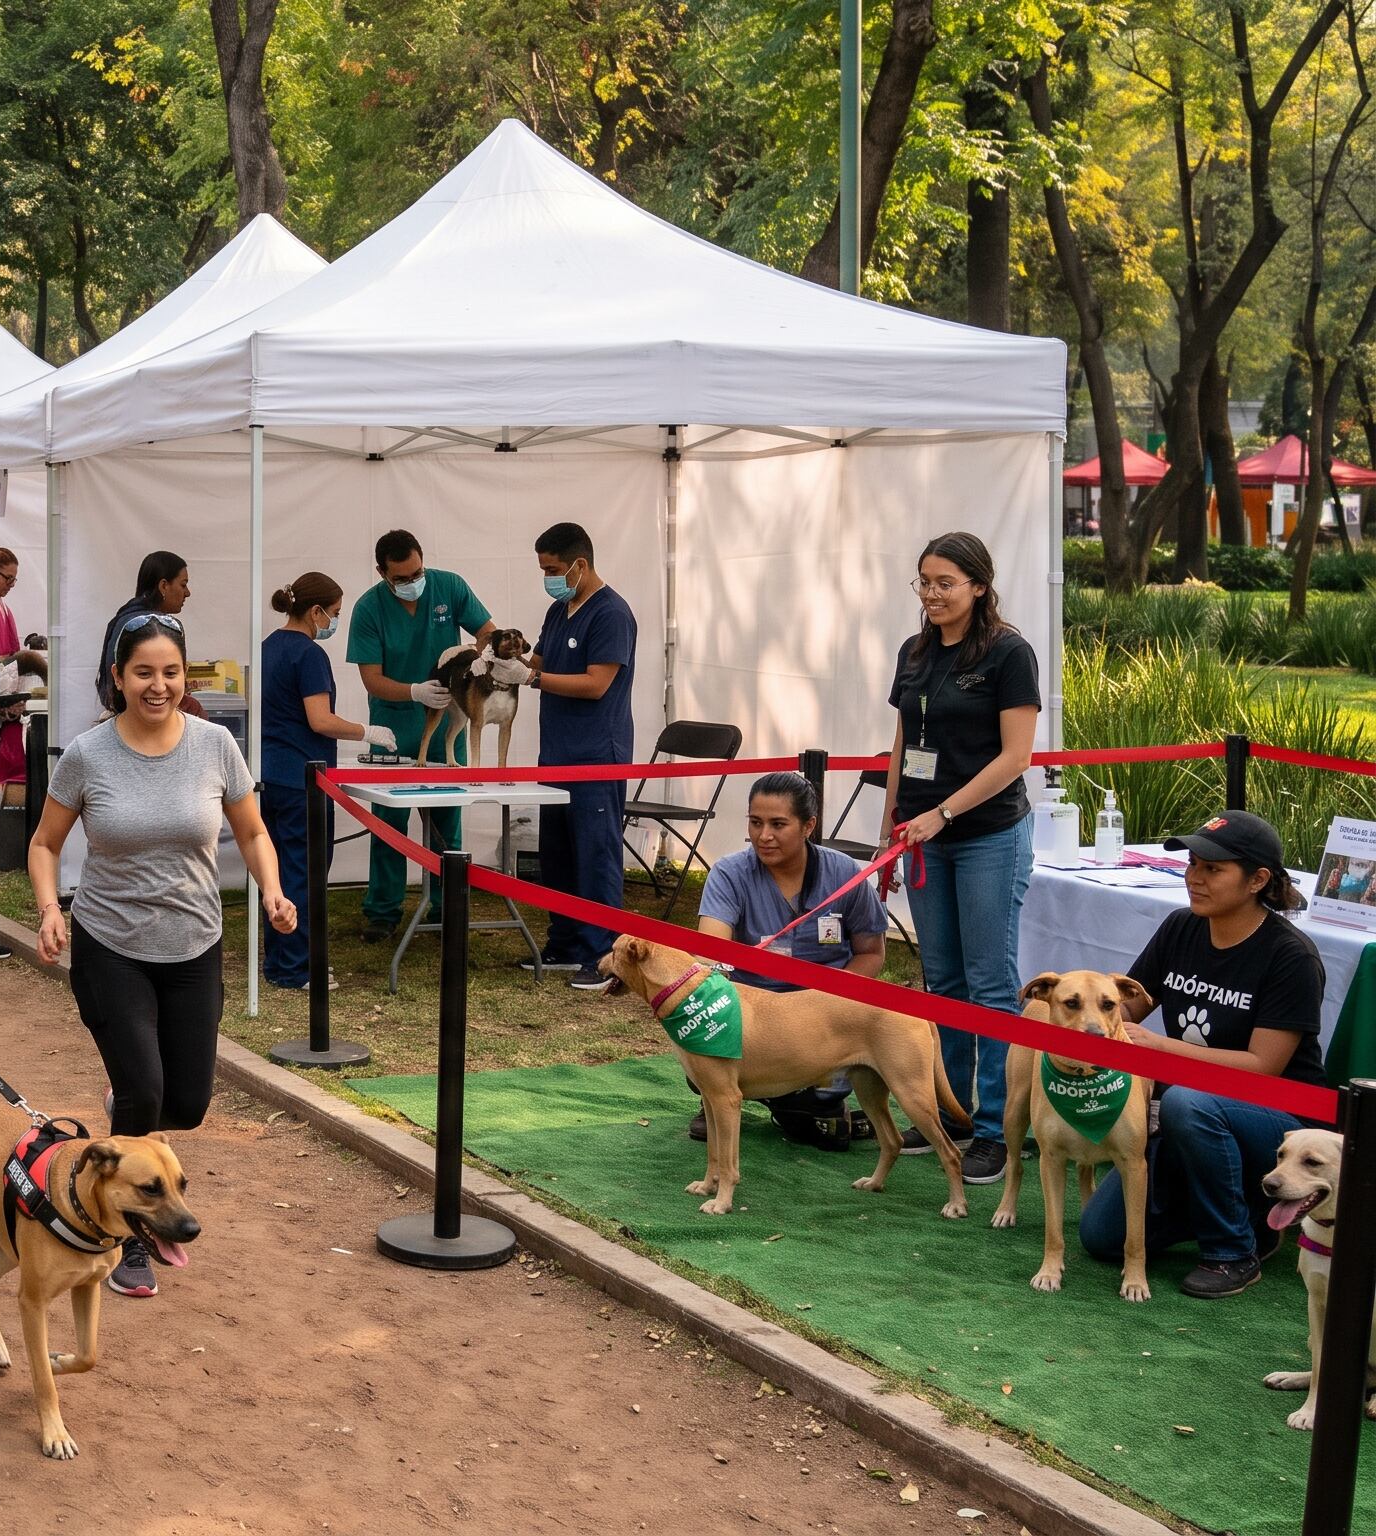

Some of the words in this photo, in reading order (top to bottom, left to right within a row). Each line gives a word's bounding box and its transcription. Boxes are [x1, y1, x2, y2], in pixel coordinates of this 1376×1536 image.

[1163, 971, 1253, 1010] ADÓPTAME
[677, 994, 731, 1040] ADOPTAME
[1048, 1075, 1125, 1098] ADOPTAME
